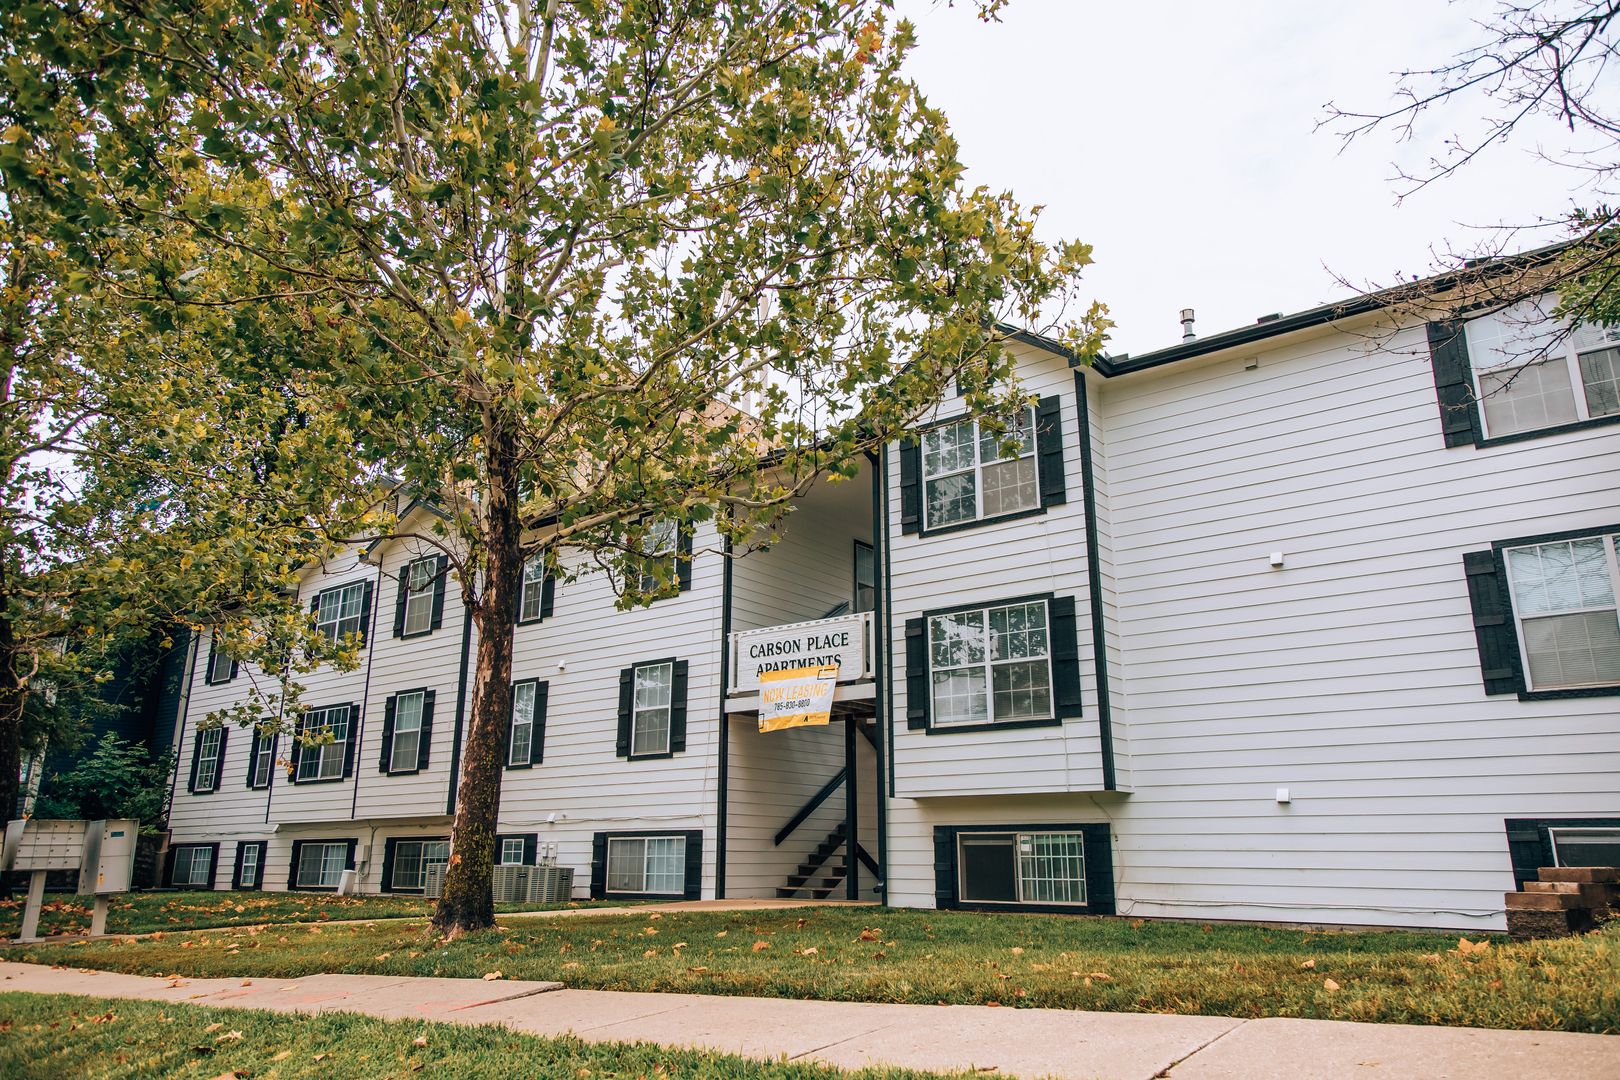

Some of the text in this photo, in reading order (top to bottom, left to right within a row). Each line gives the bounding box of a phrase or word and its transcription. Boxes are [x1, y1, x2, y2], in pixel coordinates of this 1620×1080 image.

[750, 632, 849, 658] CARSON PLACE
[763, 683, 828, 704] NOW LEASING
